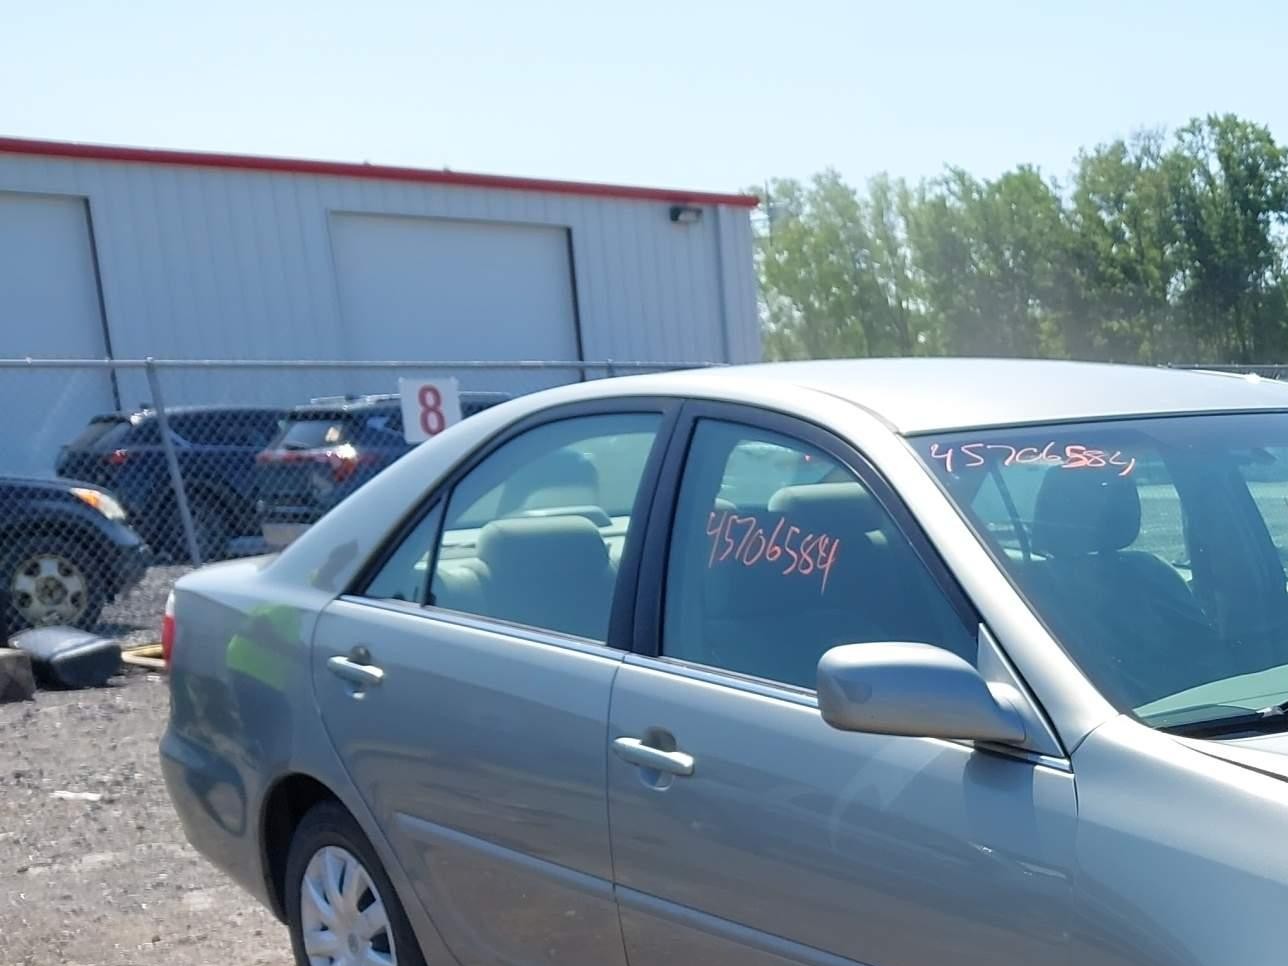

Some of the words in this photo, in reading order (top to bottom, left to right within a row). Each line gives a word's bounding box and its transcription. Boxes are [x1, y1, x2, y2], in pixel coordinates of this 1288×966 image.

[418, 384, 446, 436] 8
[930, 442, 1135, 476] 45706584
[706, 511, 840, 594] 45706584
